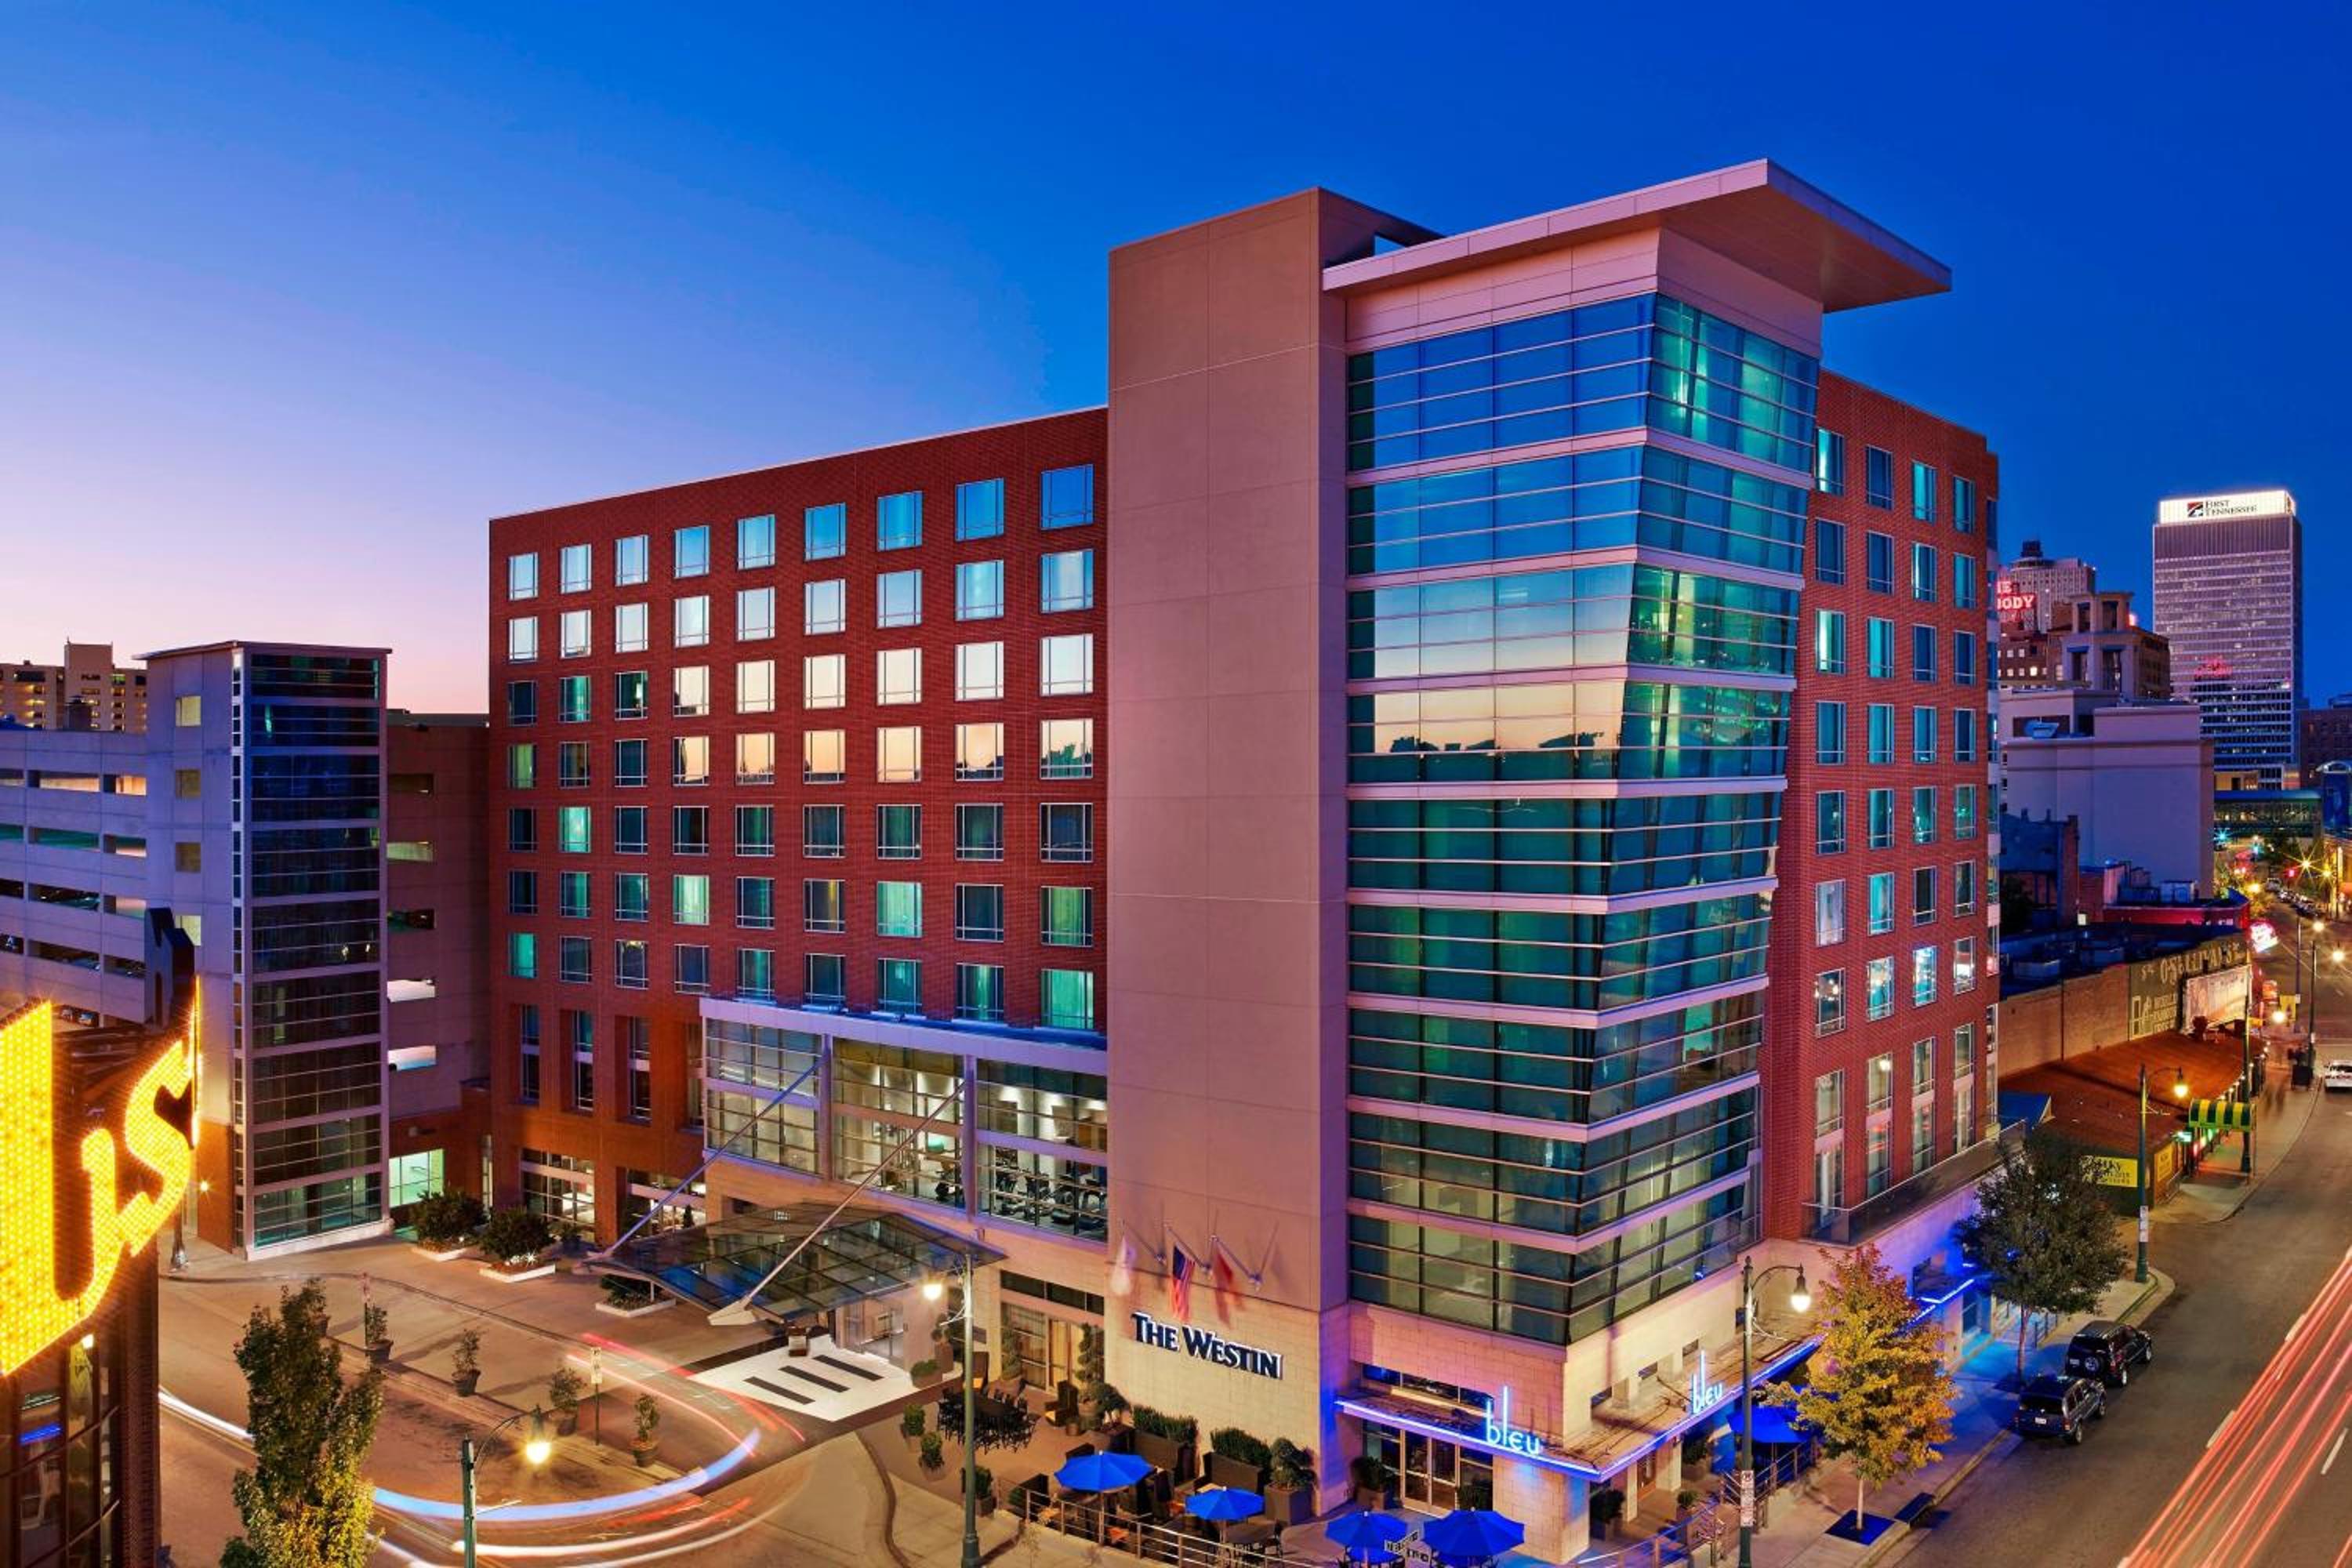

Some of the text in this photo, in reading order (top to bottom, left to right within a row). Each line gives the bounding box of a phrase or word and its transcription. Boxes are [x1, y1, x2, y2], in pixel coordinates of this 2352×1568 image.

[1131, 1312, 1283, 1381] THE WESTIN
[1693, 1349, 1722, 1414] bleu
[1486, 1385, 1541, 1456] bleu
